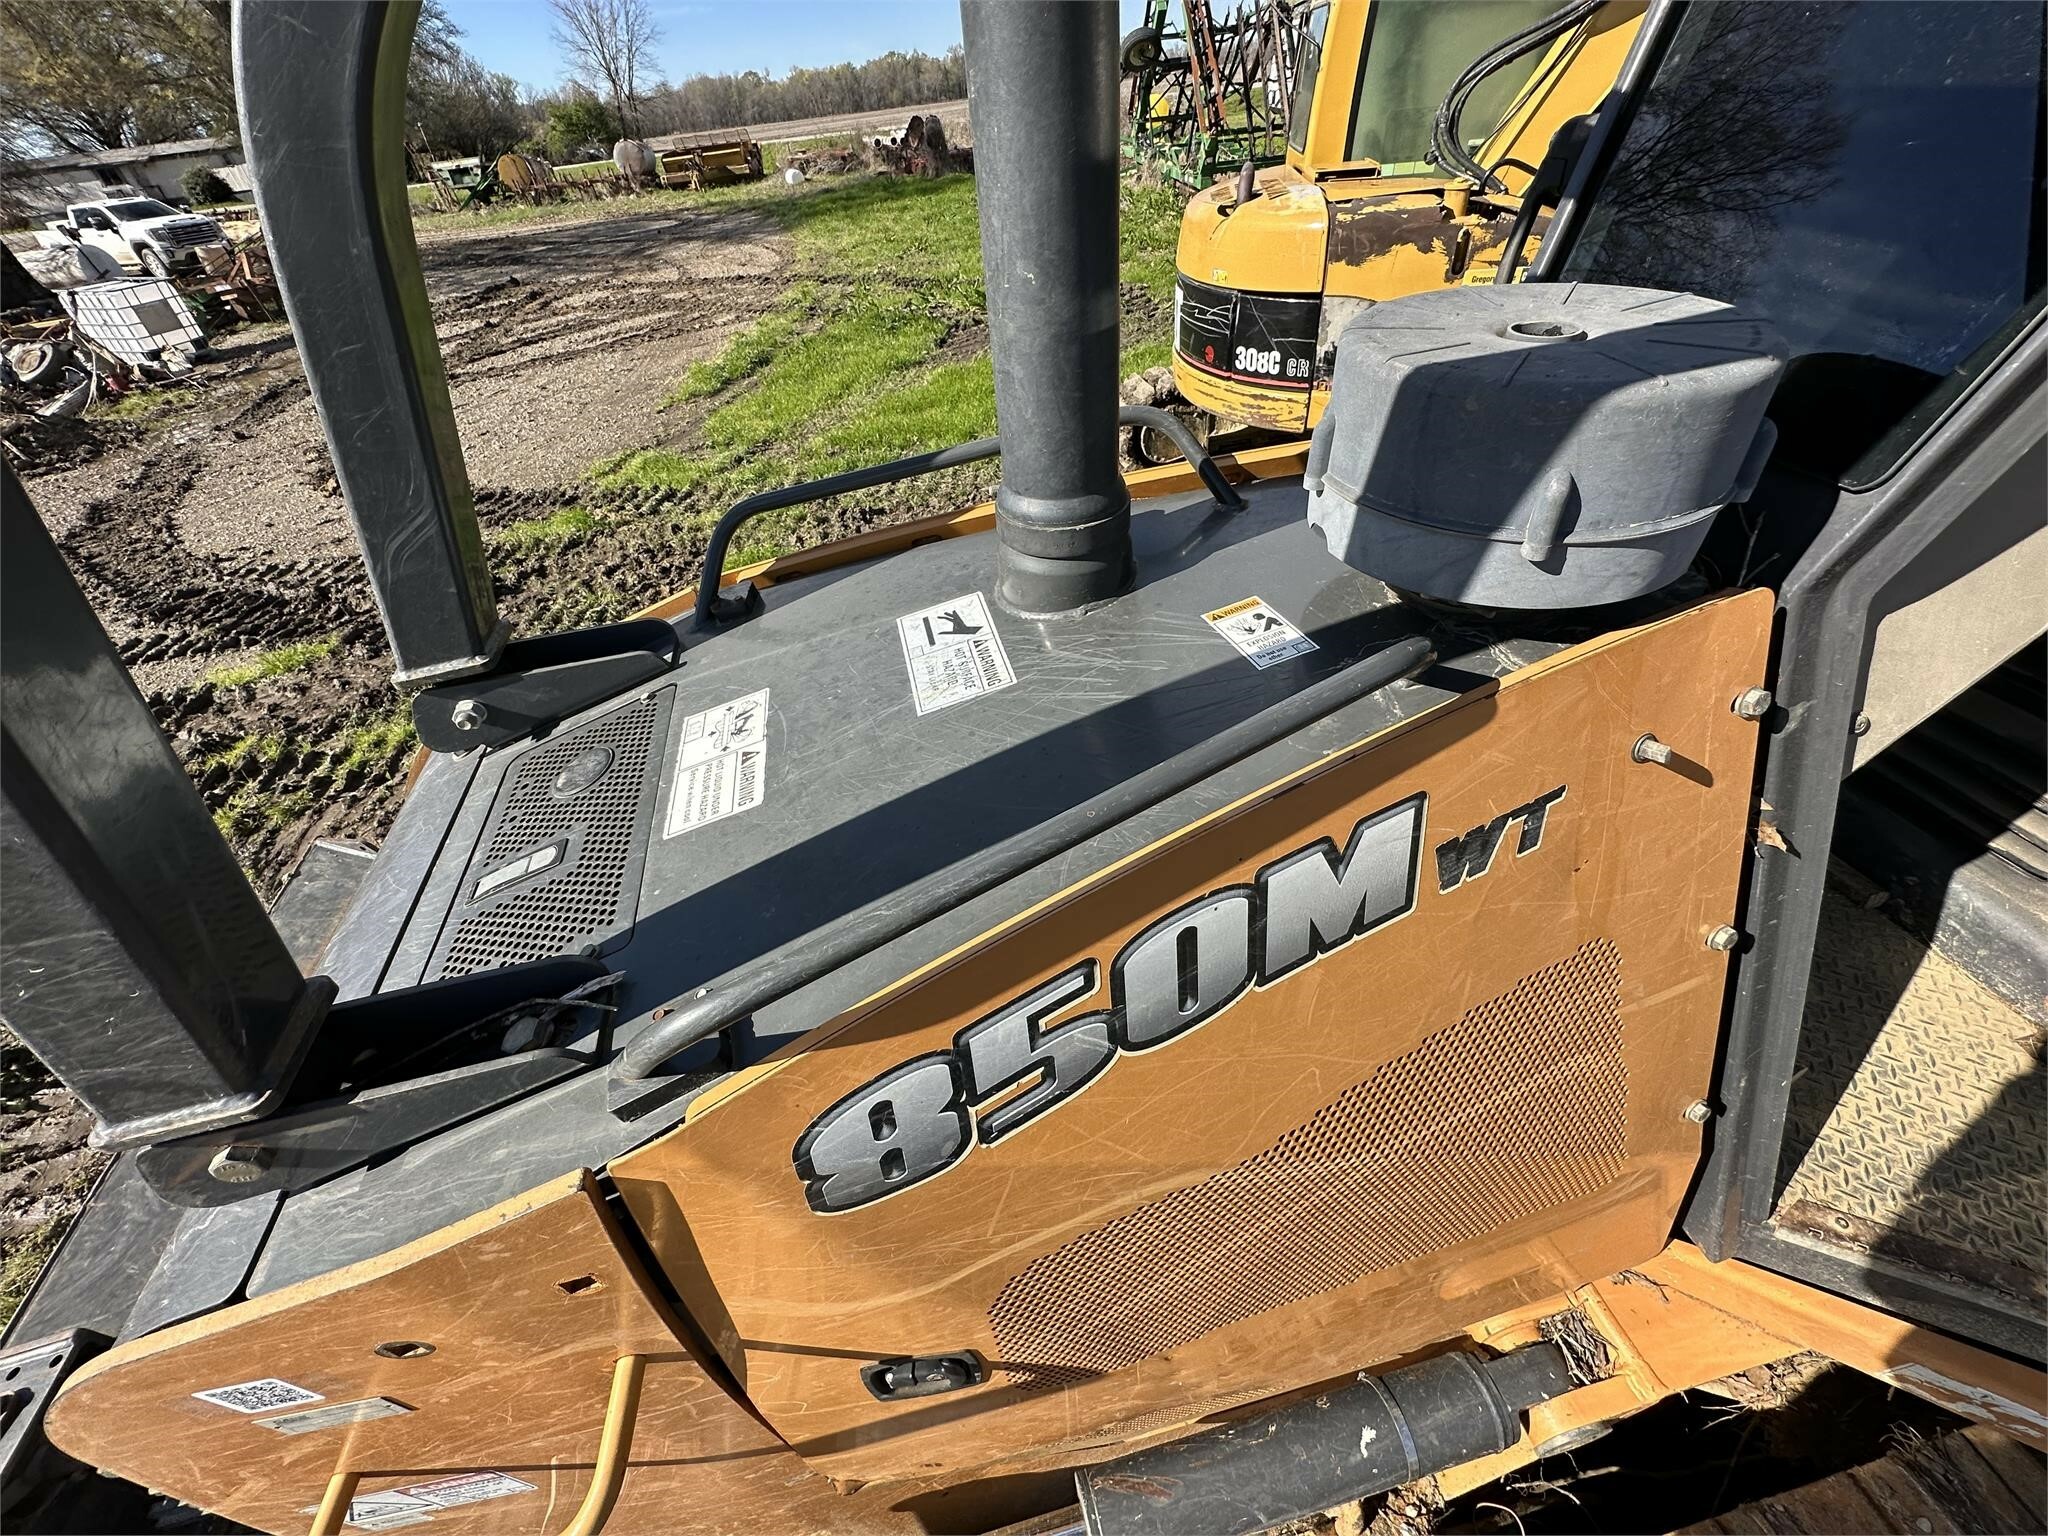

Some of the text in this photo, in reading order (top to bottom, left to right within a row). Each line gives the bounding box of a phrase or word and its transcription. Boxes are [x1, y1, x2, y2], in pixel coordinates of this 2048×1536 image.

[1471, 275, 1495, 284] Gregor
[1235, 345, 1310, 377] 308C CR
[1222, 599, 1260, 616] WARNING
[1246, 629, 1287, 647] EXPLOSION
[1256, 636, 1287, 650] HAZARD
[942, 659, 960, 686] HAZARD
[954, 647, 977, 690] HOT SURFACE
[976, 645, 1003, 687] WARNING
[682, 767, 699, 824] Service when cool
[697, 763, 713, 822] PRESSURE HAZARD
[710, 759, 725, 816] HOT LIQUID UNDER
[737, 761, 757, 807] WARNING
[793, 784, 1568, 1217] 850M WT
